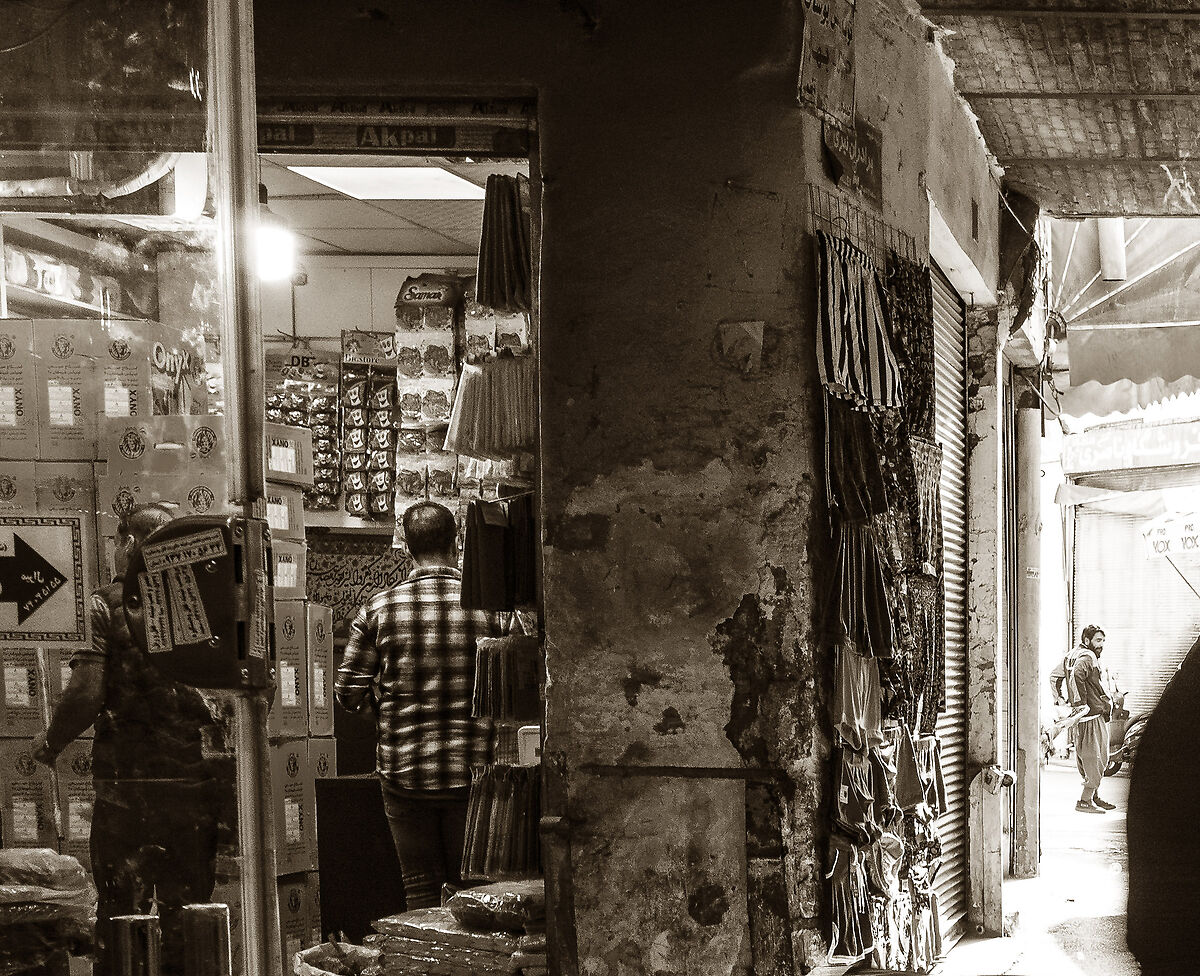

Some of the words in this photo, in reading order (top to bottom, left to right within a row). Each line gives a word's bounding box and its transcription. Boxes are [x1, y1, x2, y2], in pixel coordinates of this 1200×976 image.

[153, 341, 191, 384] Onyx
[15, 388, 24, 417] ONYX
[72, 388, 82, 417] ONYX
[1153, 539, 1171, 553] VOX
[1181, 535, 1199, 549] VOX
